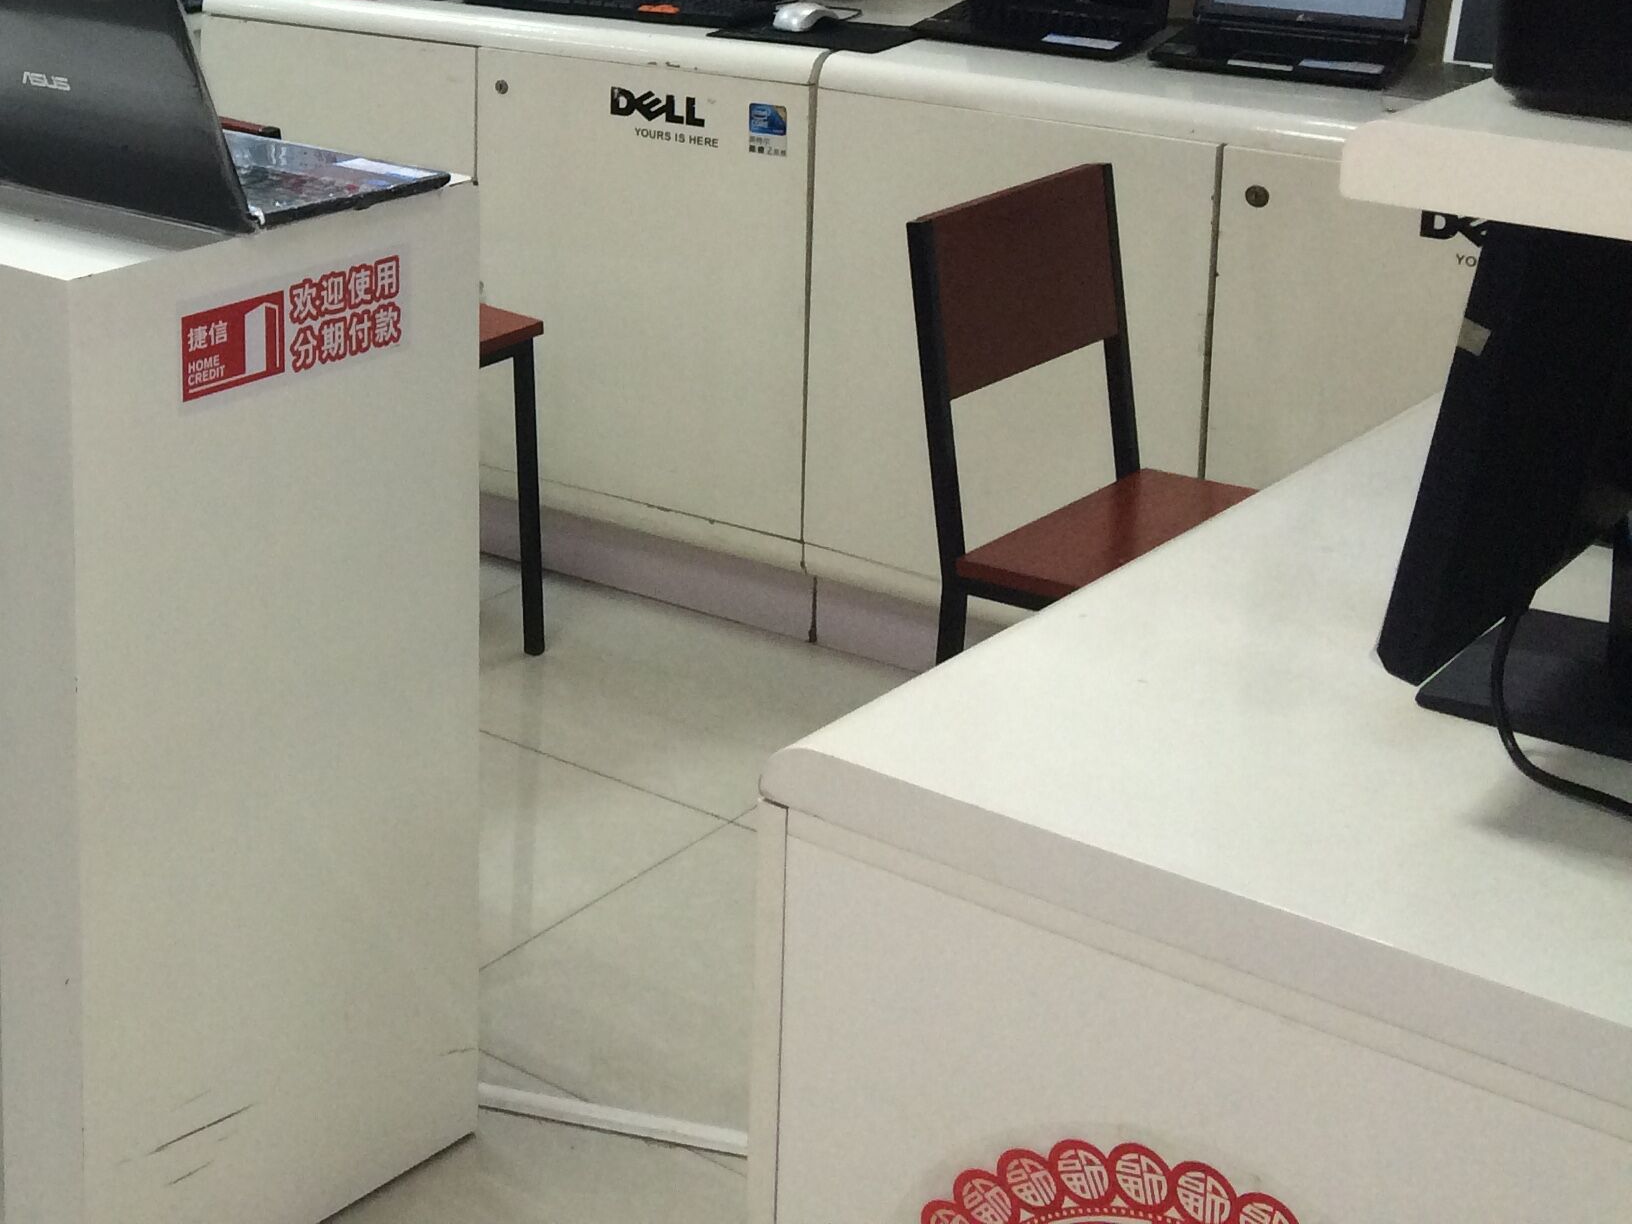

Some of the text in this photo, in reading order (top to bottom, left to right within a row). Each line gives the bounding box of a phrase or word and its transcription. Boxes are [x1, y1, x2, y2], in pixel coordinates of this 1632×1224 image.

[21, 70, 71, 92] ASUS
[609, 86, 706, 128] DELL
[634, 127, 719, 149] YOURS IS HERE
[291, 258, 398, 319] 欢迎使用
[187, 320, 229, 353] 捷信
[294, 304, 399, 369] 分期付款
[187, 354, 221, 374] HOME
[187, 365, 226, 387] CREDIT
